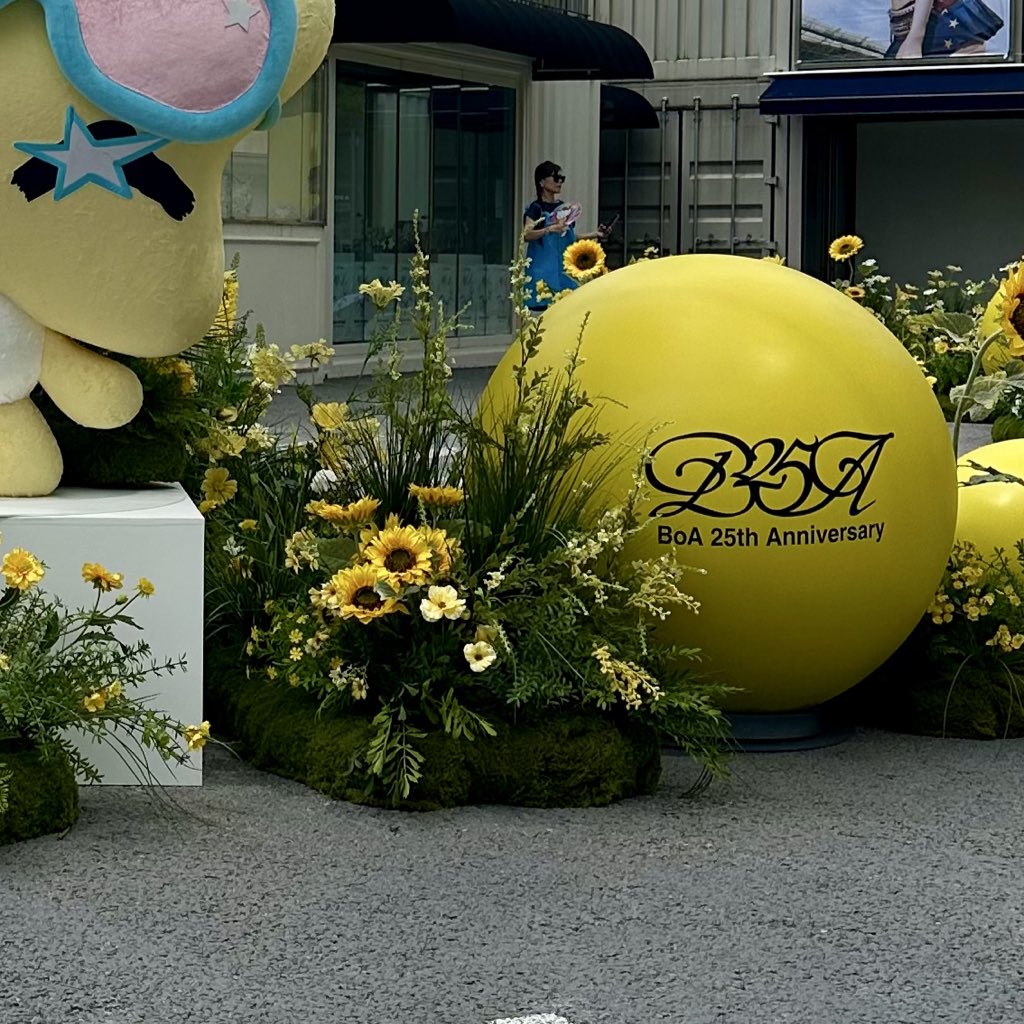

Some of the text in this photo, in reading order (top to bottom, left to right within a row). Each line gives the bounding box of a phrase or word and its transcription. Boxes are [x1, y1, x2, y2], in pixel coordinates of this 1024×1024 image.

[657, 521, 885, 547] BoA 25th Anniversary
